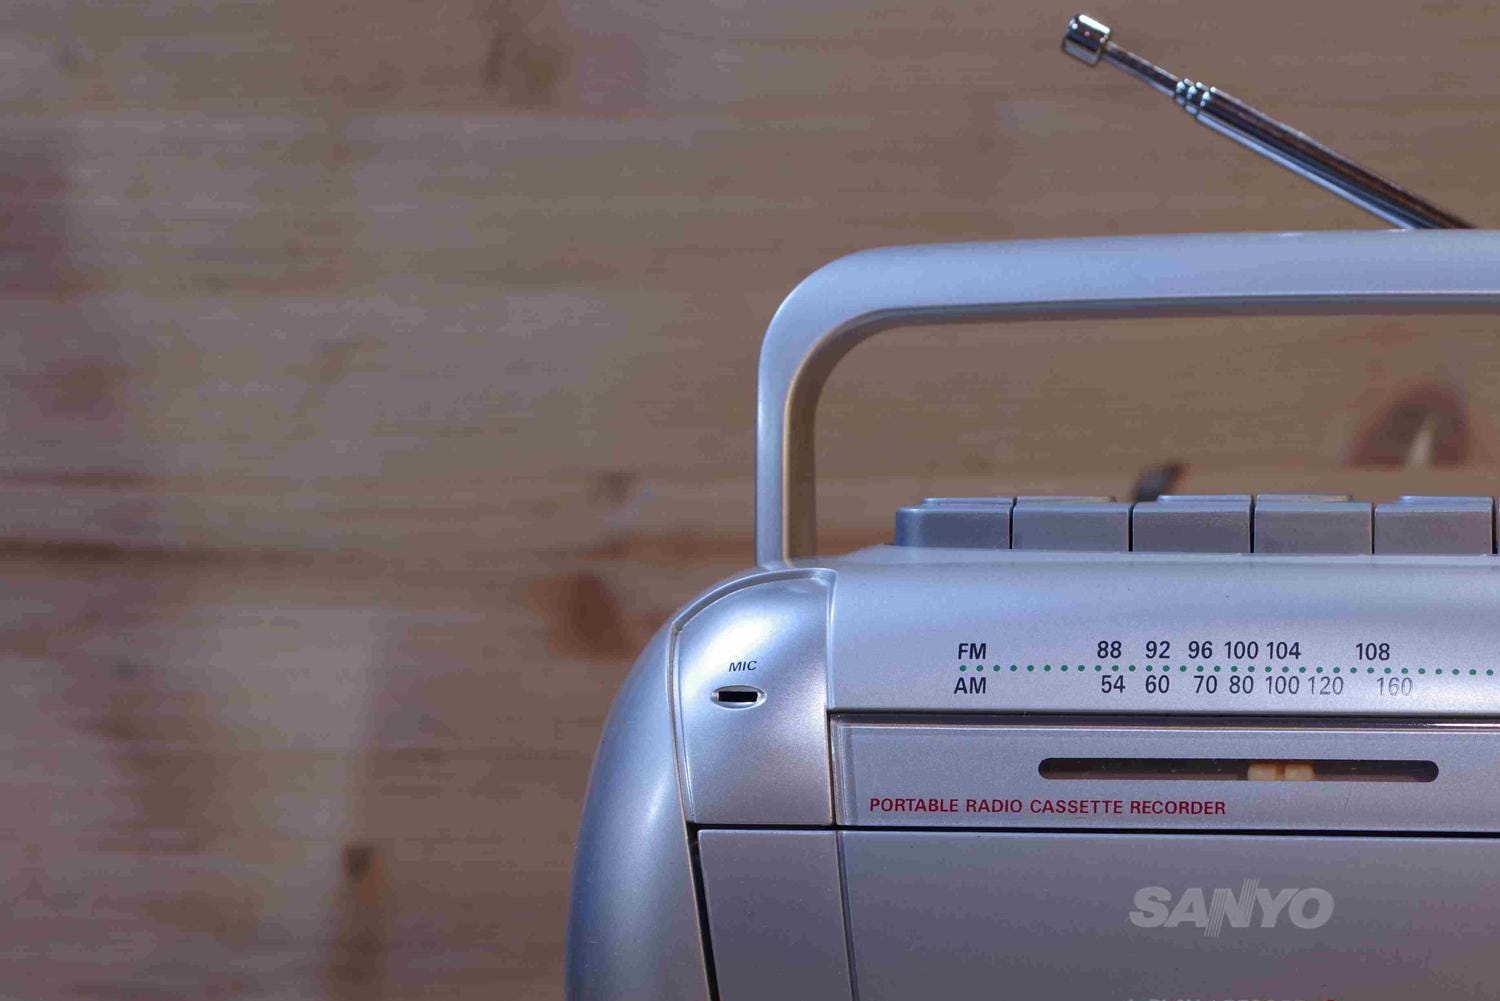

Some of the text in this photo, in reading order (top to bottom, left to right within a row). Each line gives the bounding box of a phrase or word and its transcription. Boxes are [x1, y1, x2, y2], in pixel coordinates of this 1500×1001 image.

[957, 643, 987, 660] FM
[1097, 640, 1122, 659] 88
[1145, 640, 1170, 659] 92
[1188, 641, 1213, 659] 96
[1224, 641, 1259, 660] 100
[1266, 641, 1302, 660] 104
[1355, 642, 1391, 661] 108
[728, 660, 758, 673] MIC
[953, 676, 987, 695] AM
[1101, 675, 1126, 694] 54
[1145, 675, 1170, 694] 60
[1193, 675, 1218, 694] 70
[1229, 675, 1254, 694] 80
[1265, 675, 1300, 695] 100
[1307, 676, 1344, 695] 120
[1376, 677, 1414, 697] 160
[869, 798, 1226, 816] PORTABLE RADIO CASSETTE RECORDER
[1128, 878, 1335, 937] SANYO
